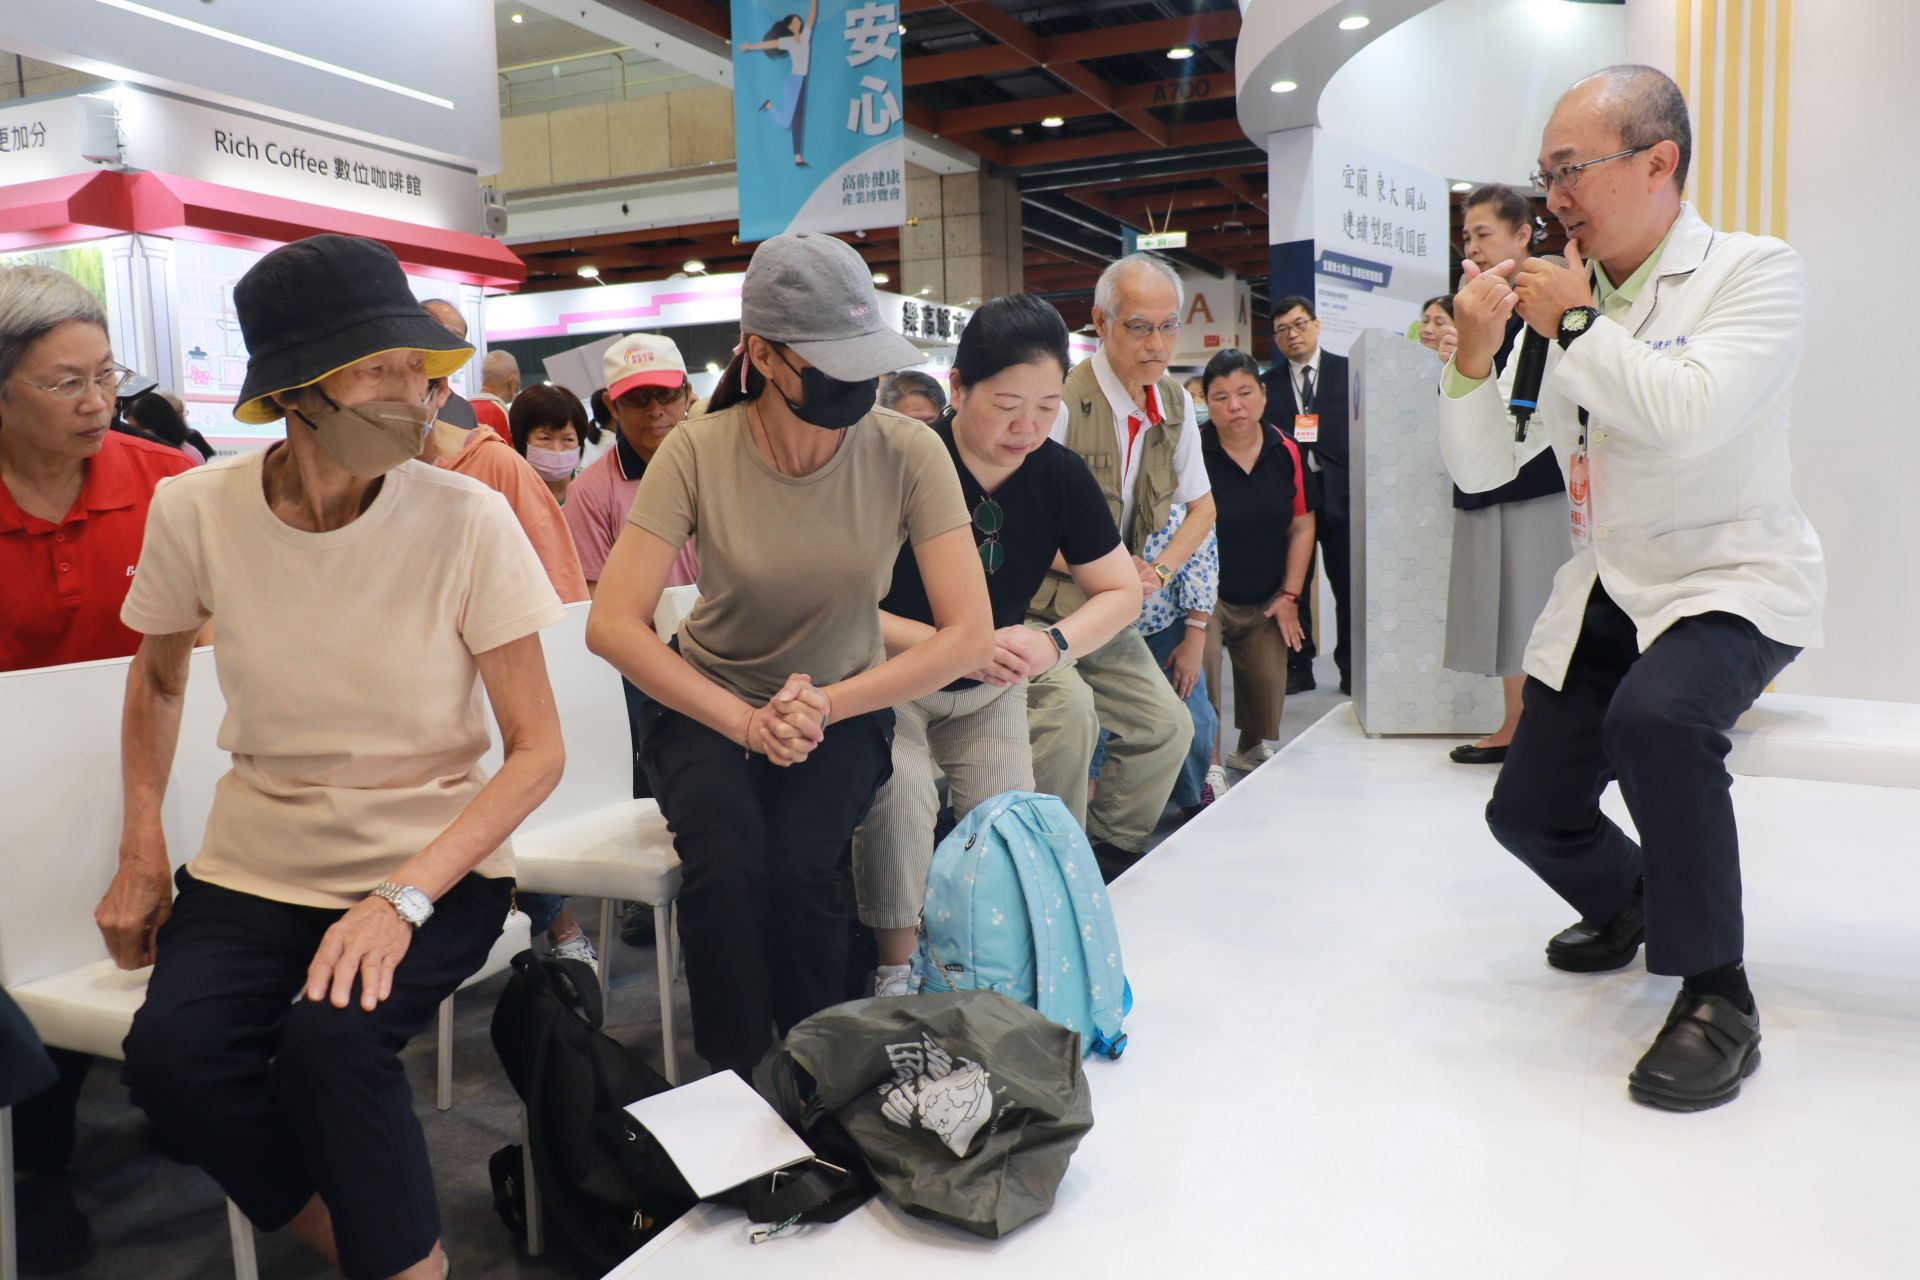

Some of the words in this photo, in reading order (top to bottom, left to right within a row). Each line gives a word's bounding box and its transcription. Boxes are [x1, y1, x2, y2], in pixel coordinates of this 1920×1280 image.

[844, 1, 902, 136] 安心
[1152, 79, 1211, 103] A700
[214, 128, 259, 161] Rich
[265, 143, 328, 176] Coffee
[334, 157, 422, 197] 數位咖啡館
[842, 169, 900, 192] 高齡健康
[1185, 292, 1214, 325] A
